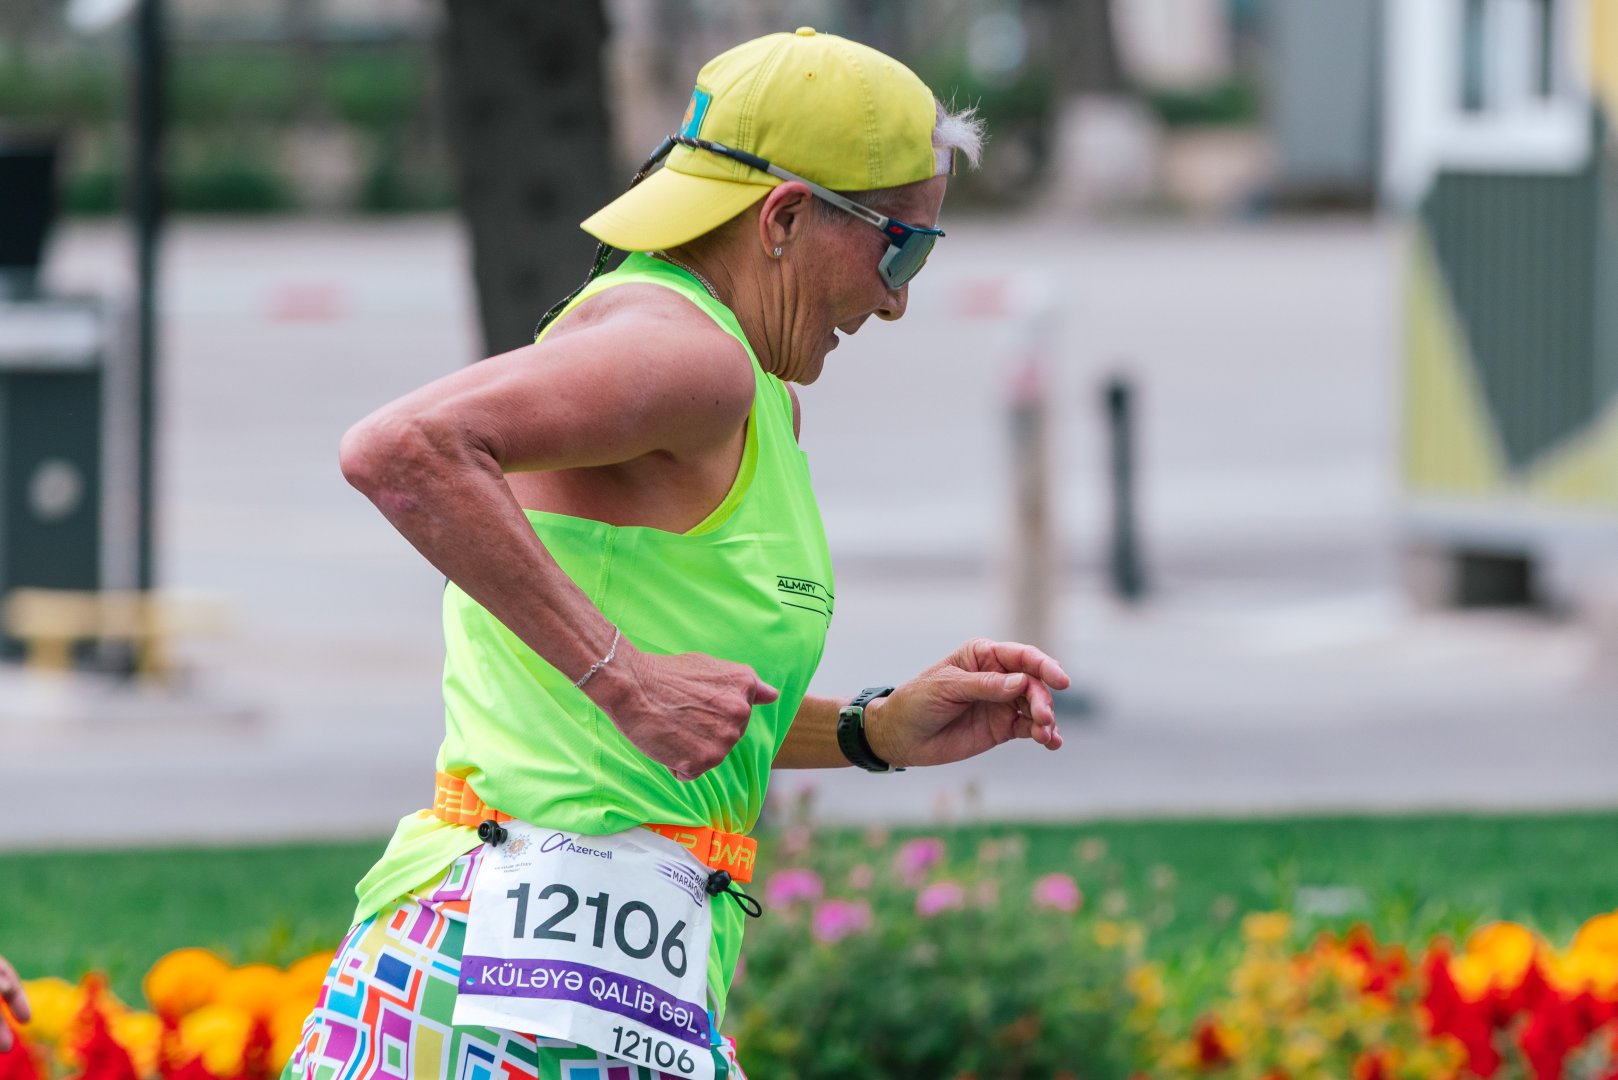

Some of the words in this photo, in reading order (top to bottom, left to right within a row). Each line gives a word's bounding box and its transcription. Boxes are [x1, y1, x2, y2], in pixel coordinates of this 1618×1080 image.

[777, 579, 816, 594] ALMATY
[566, 842, 613, 860] Azercell
[506, 882, 688, 978] 12106
[481, 962, 583, 991] KÜLƏYƏ
[589, 976, 655, 1014] QALİB
[659, 1002, 699, 1034] GƏL
[612, 1025, 695, 1075] 12106
